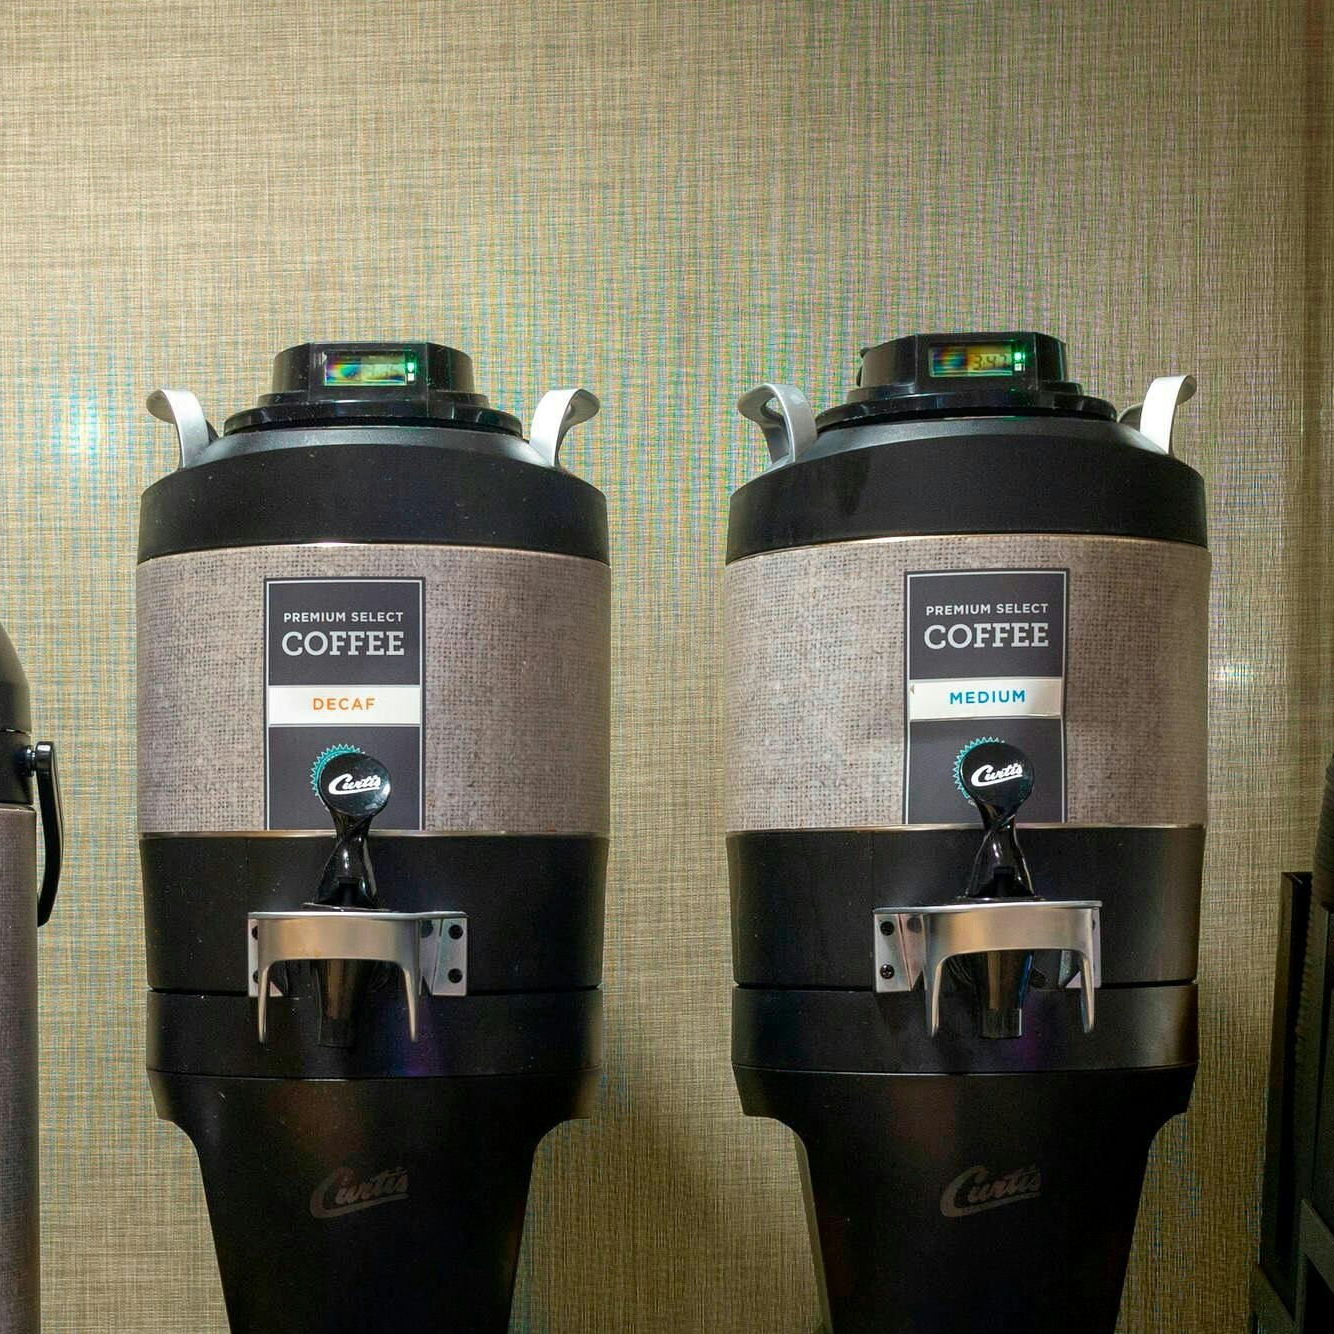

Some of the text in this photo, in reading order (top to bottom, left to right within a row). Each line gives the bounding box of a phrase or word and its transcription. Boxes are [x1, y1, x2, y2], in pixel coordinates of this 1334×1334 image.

[283, 611, 404, 623] PREMIUM SELECT
[925, 603, 1049, 617] PREMIUM SELECT
[281, 630, 405, 657] COFFEE
[923, 622, 1049, 650] COFFEE
[312, 697, 376, 711] DECAF
[949, 689, 1026, 705] MEDIUM
[328, 773, 381, 795] Curtis
[970, 763, 1024, 788] Curtis
